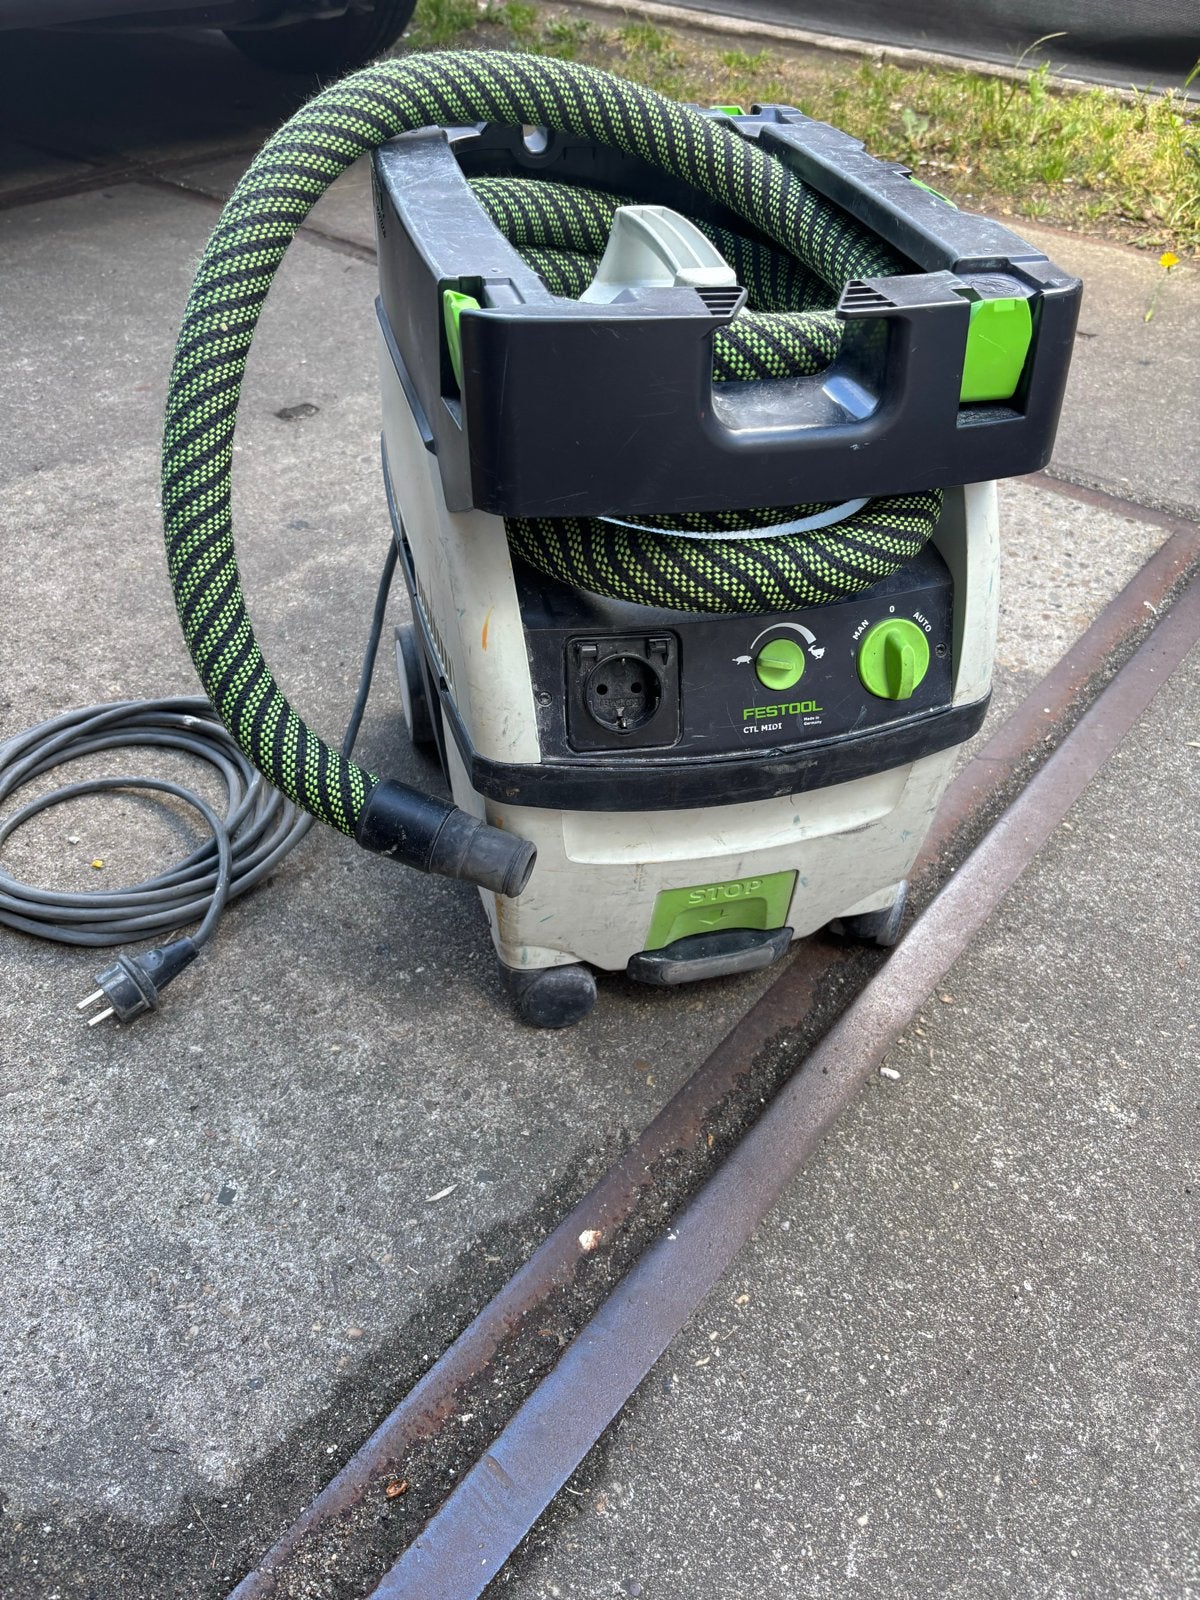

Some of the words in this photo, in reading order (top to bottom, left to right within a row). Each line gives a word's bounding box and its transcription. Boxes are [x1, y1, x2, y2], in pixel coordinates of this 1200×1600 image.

[852, 619, 870, 640] MAN
[912, 611, 932, 633] AUTO
[743, 700, 823, 720] FESTOOL
[761, 722, 782, 732] MIDI
[689, 879, 763, 904] STOP
